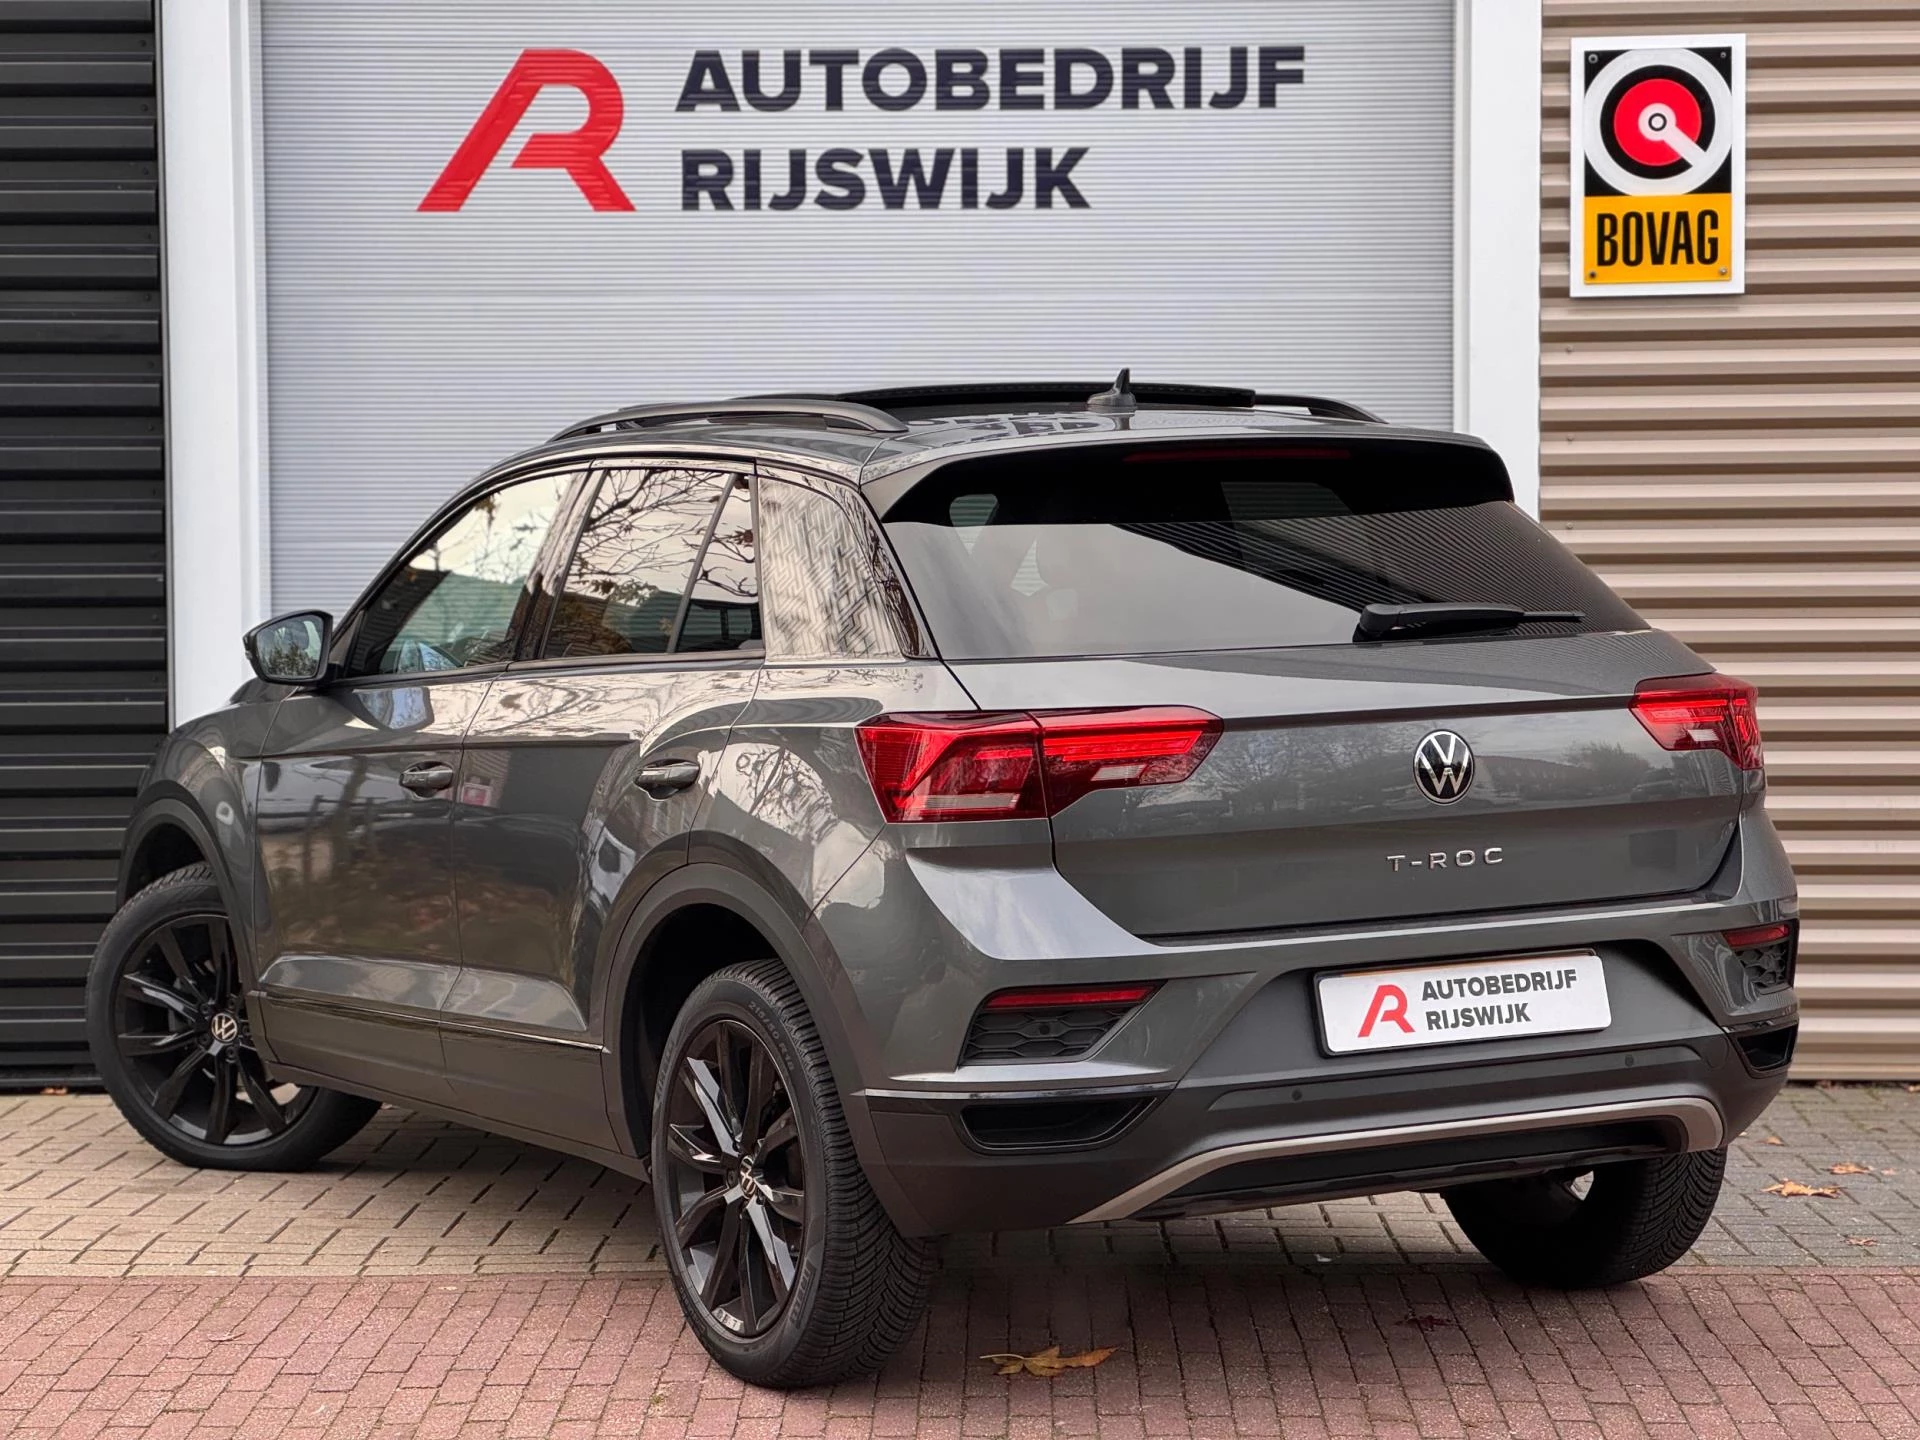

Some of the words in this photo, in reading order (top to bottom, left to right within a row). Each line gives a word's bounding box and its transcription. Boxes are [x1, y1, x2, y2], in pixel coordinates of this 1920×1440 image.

[677, 46, 1305, 113] AUTOBEDRIJF
[682, 147, 1089, 210] RIJSWIJK
[1597, 209, 1719, 267] BOVAG
[1387, 847, 1503, 872] T-ROC
[1421, 968, 1577, 1001] AUTOBEDRIJF
[1425, 1002, 1531, 1031] RIJSWIJK
